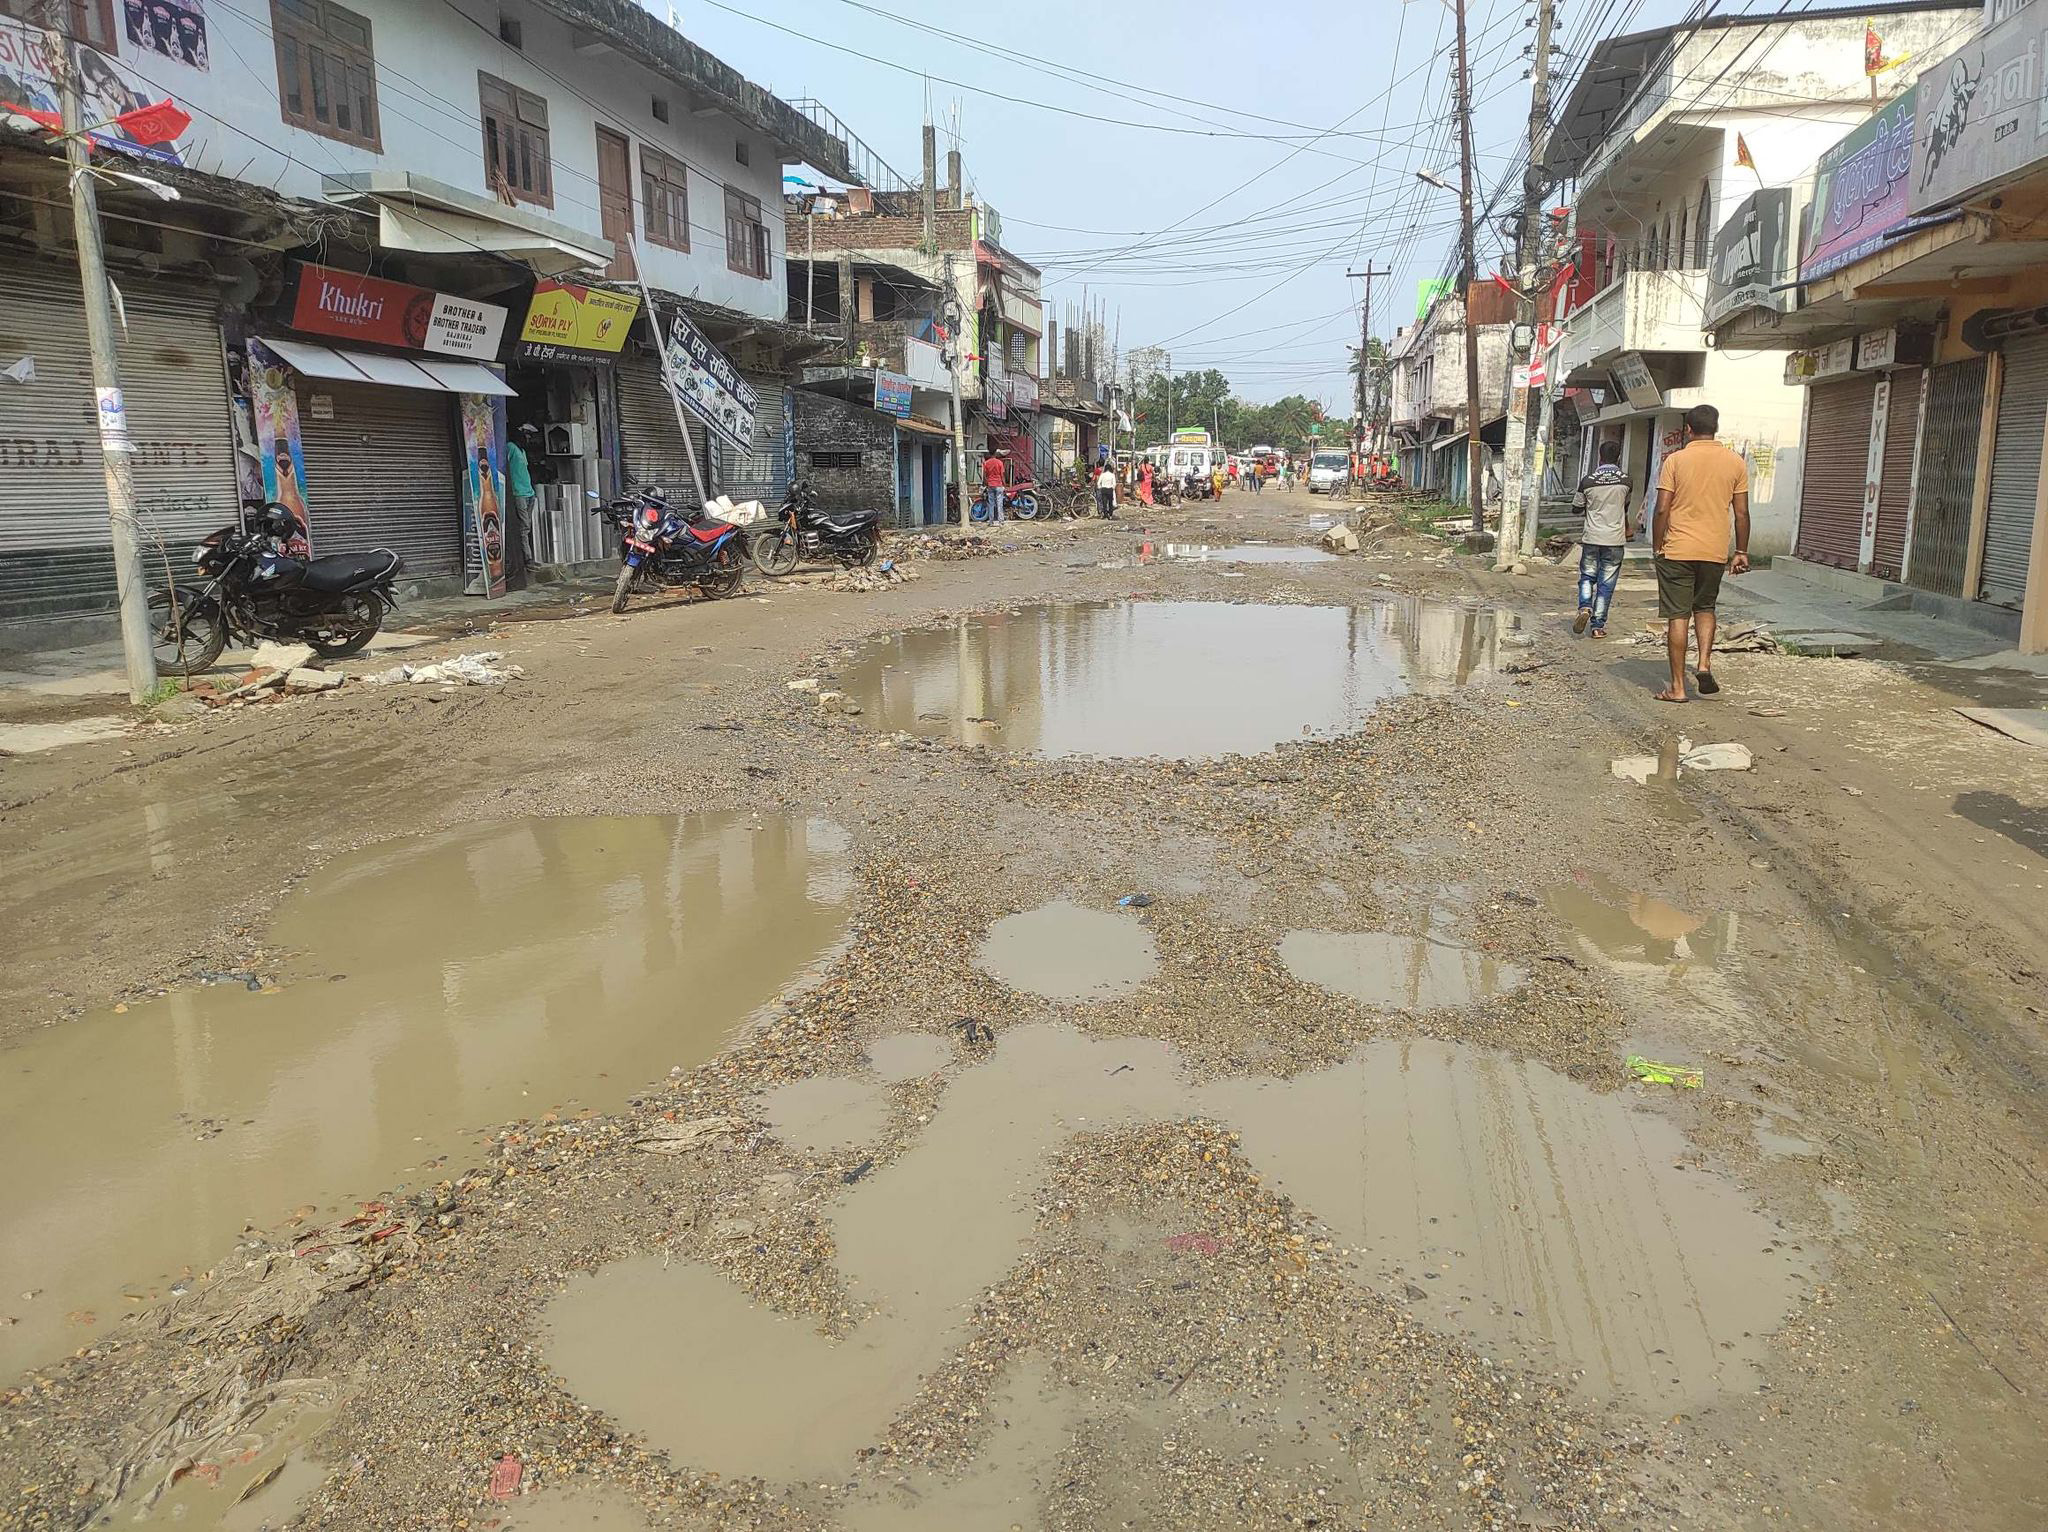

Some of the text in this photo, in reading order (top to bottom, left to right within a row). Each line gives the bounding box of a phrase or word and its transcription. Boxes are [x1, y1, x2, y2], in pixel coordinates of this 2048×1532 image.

[319, 282, 384, 320] Khukri
[443, 304, 483, 322] BROTHER &
[433, 316, 487, 336] BROTHER TRADERS
[558, 319, 573, 332] PLY
[1864, 384, 1887, 538] EXIDE
